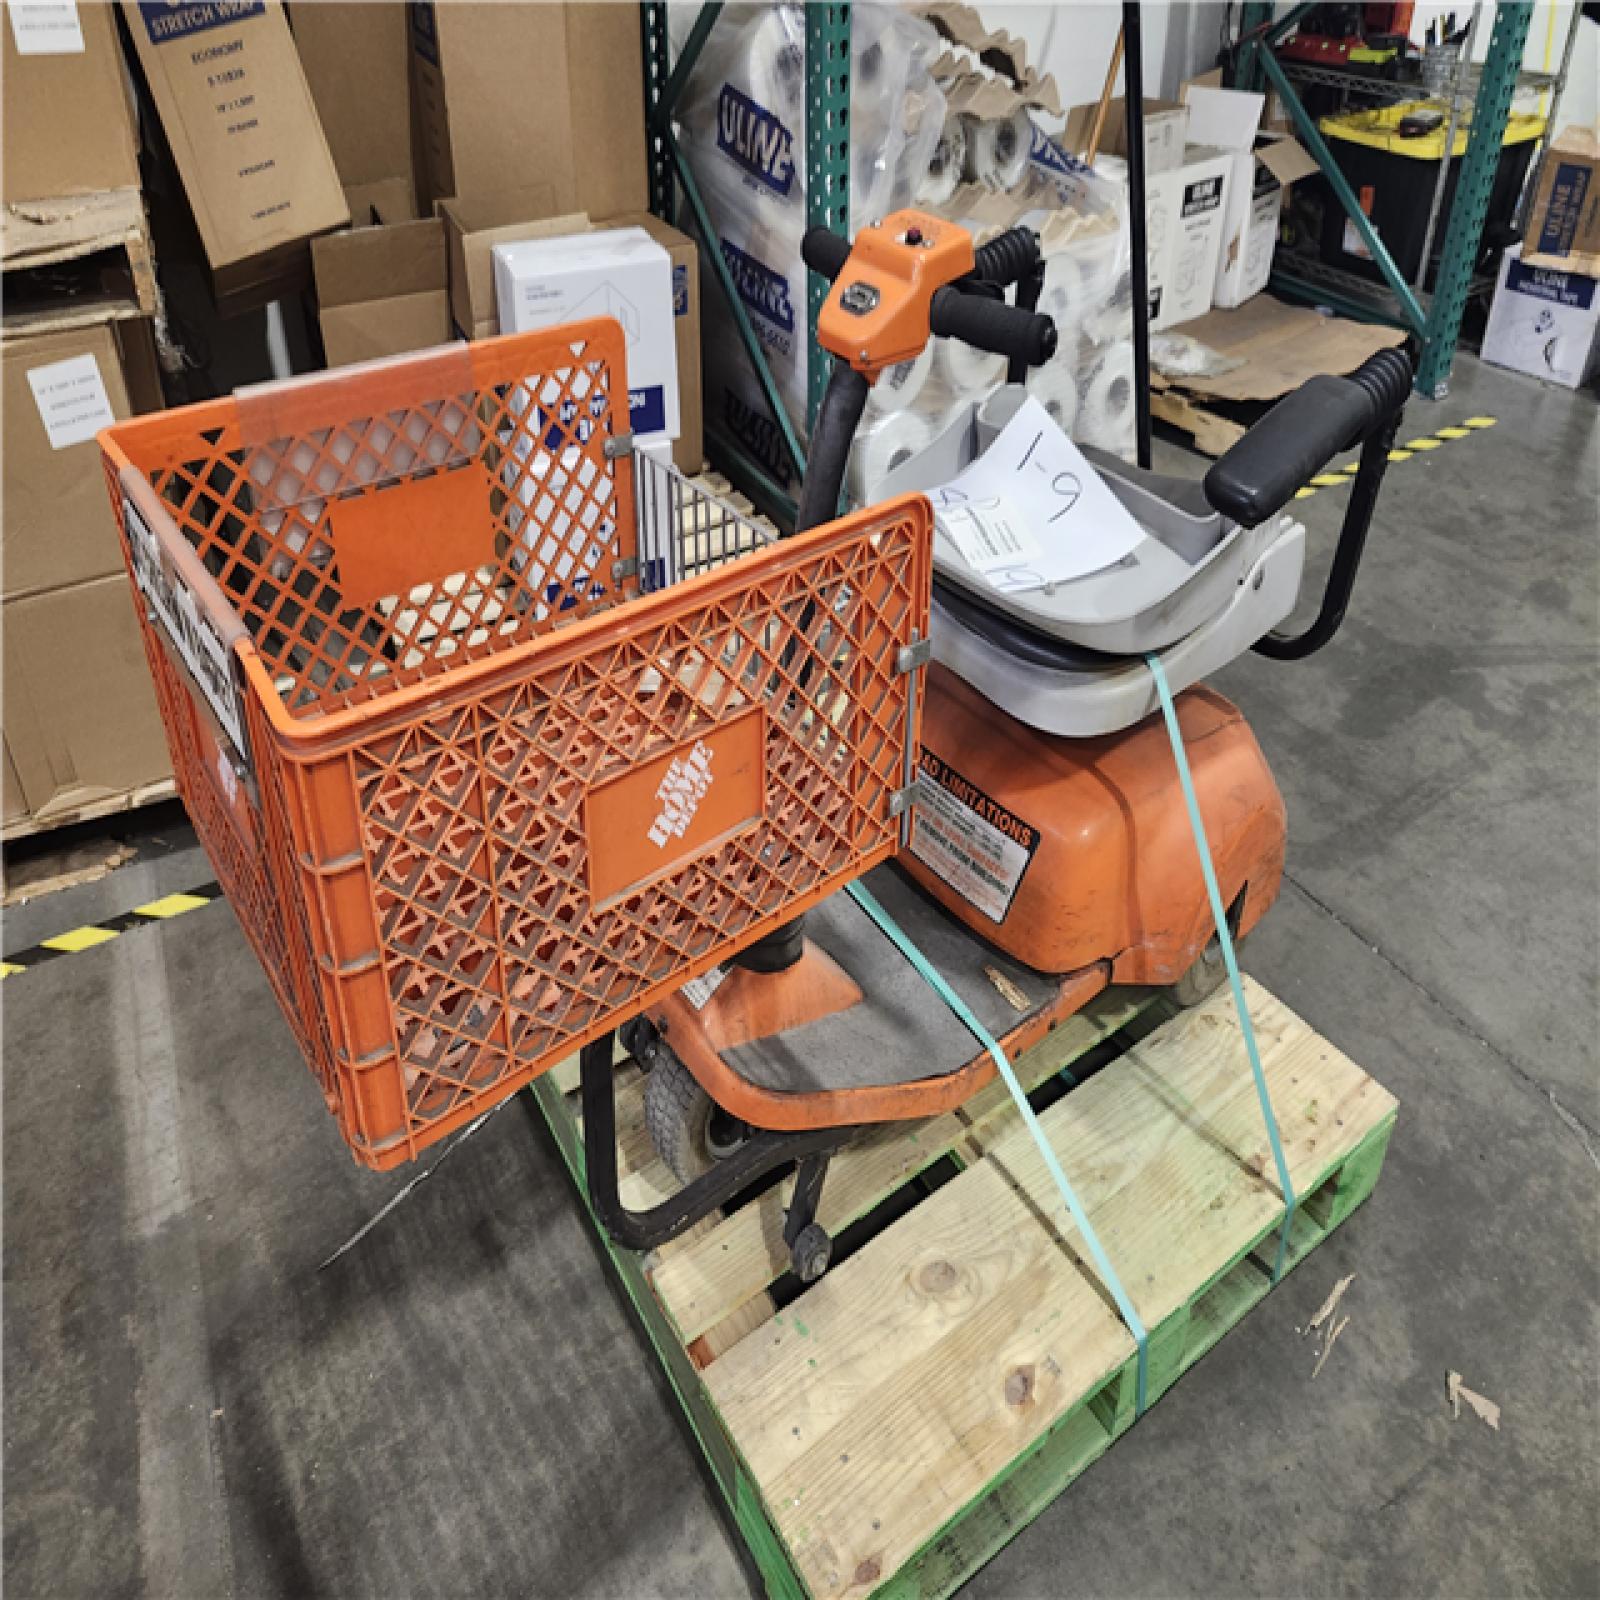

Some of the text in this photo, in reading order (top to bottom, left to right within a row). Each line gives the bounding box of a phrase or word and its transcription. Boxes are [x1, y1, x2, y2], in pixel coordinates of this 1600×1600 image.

[152, 4, 216, 37] STRETCH
[722, 94, 792, 181] ULINE
[941, 768, 1032, 847] LIMITATIONS
